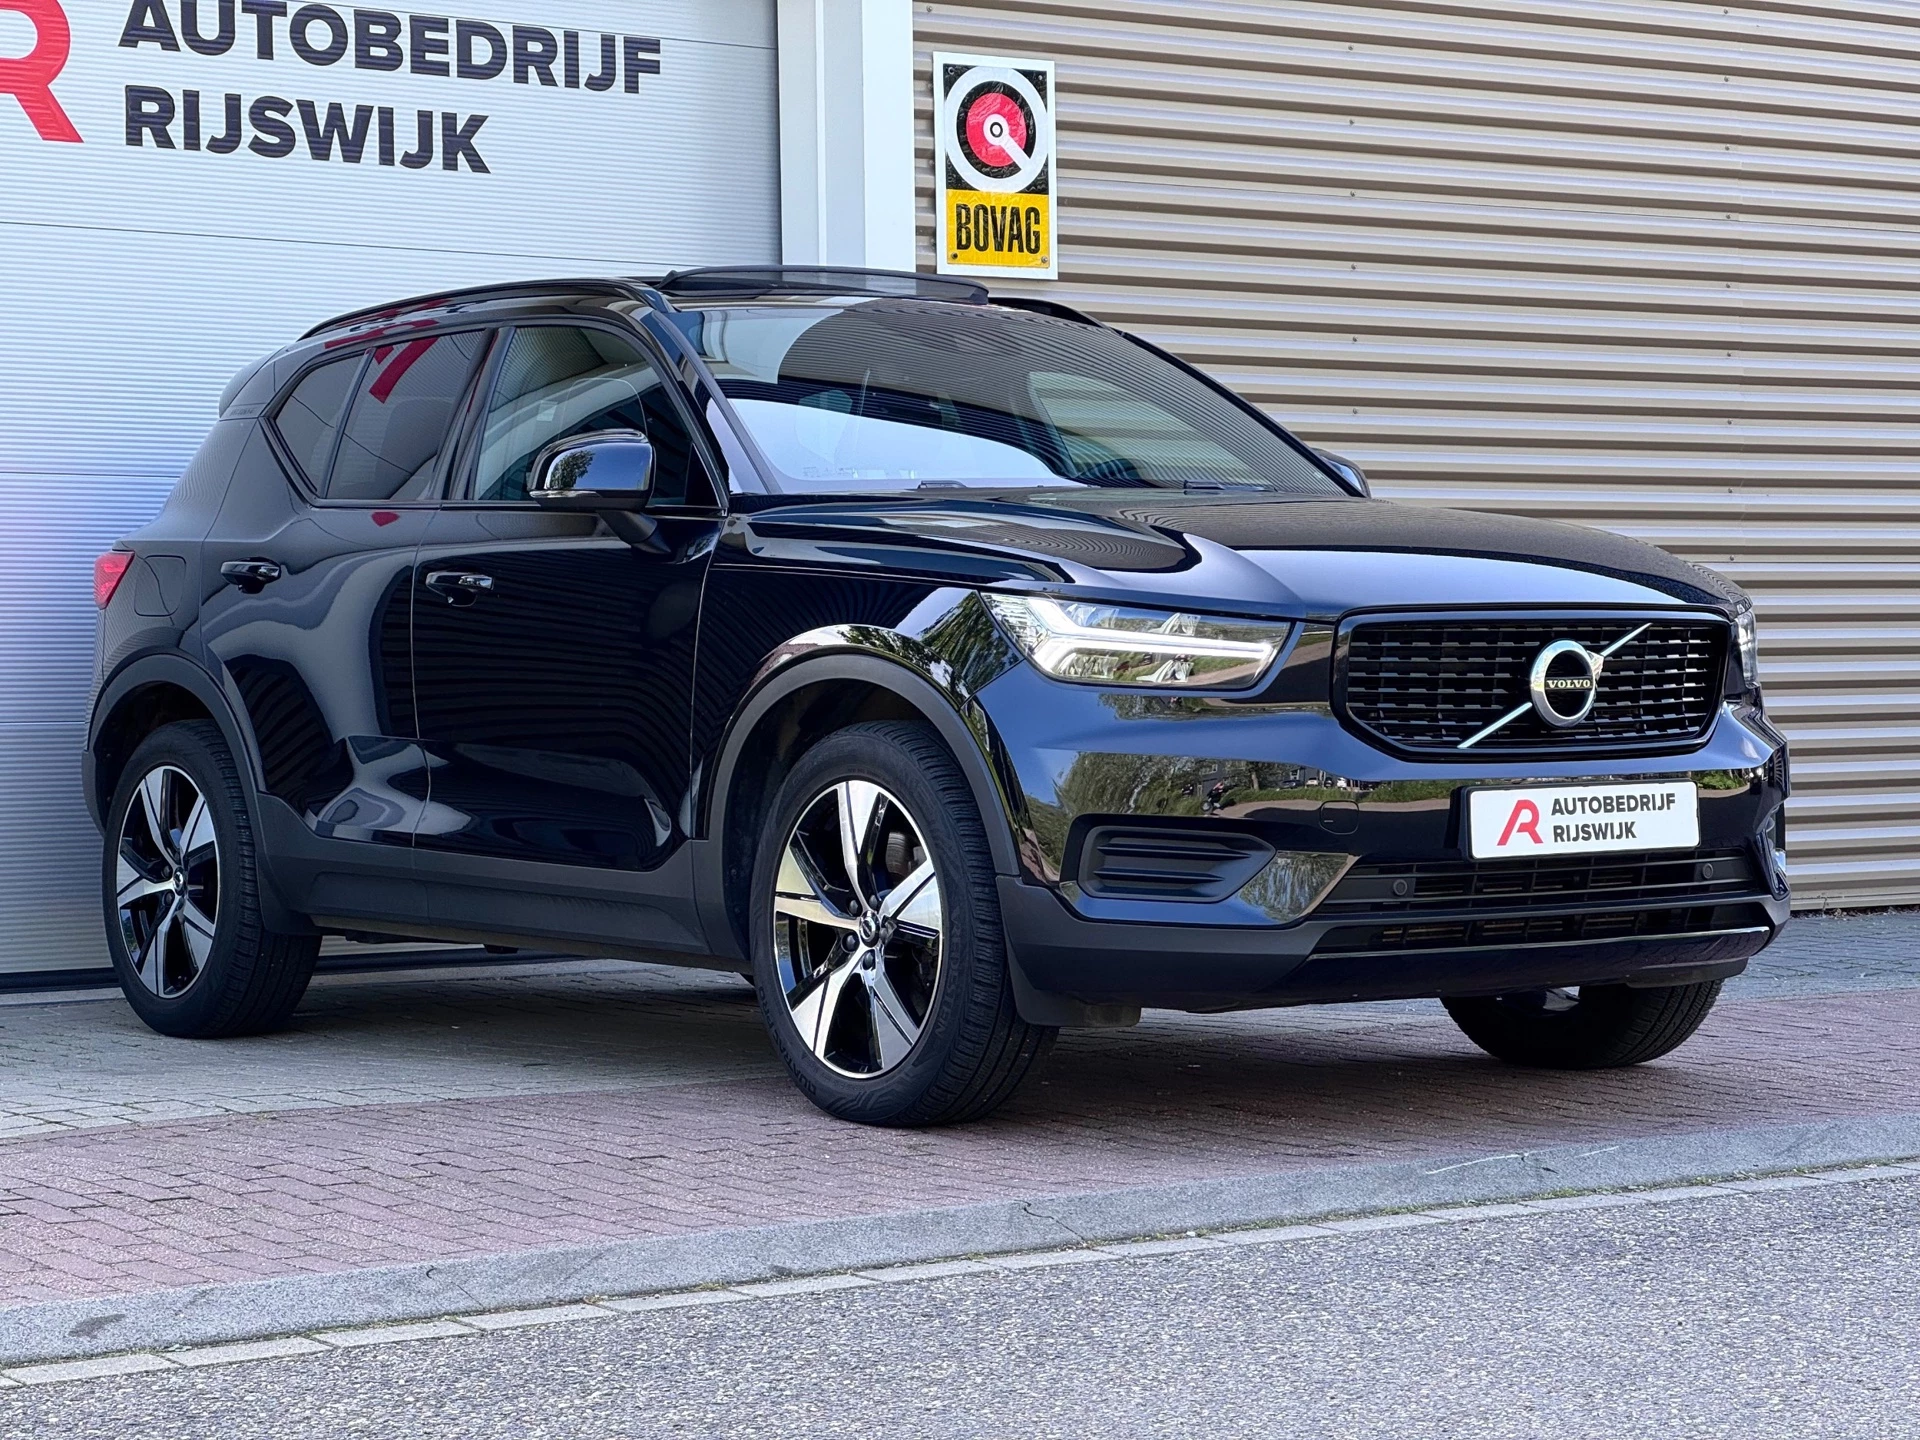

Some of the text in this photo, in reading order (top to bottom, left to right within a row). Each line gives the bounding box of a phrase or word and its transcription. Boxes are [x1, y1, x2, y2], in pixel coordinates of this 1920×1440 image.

[119, 0, 661, 94] AUTOBEDRIJF
[124, 84, 491, 174] RIJSWIJK
[955, 203, 1041, 255] BOVAG
[1546, 679, 1591, 689] VOLVO
[1551, 792, 1676, 816] AUTOBEDRIJF
[1553, 821, 1637, 843] RIJSWIJK
